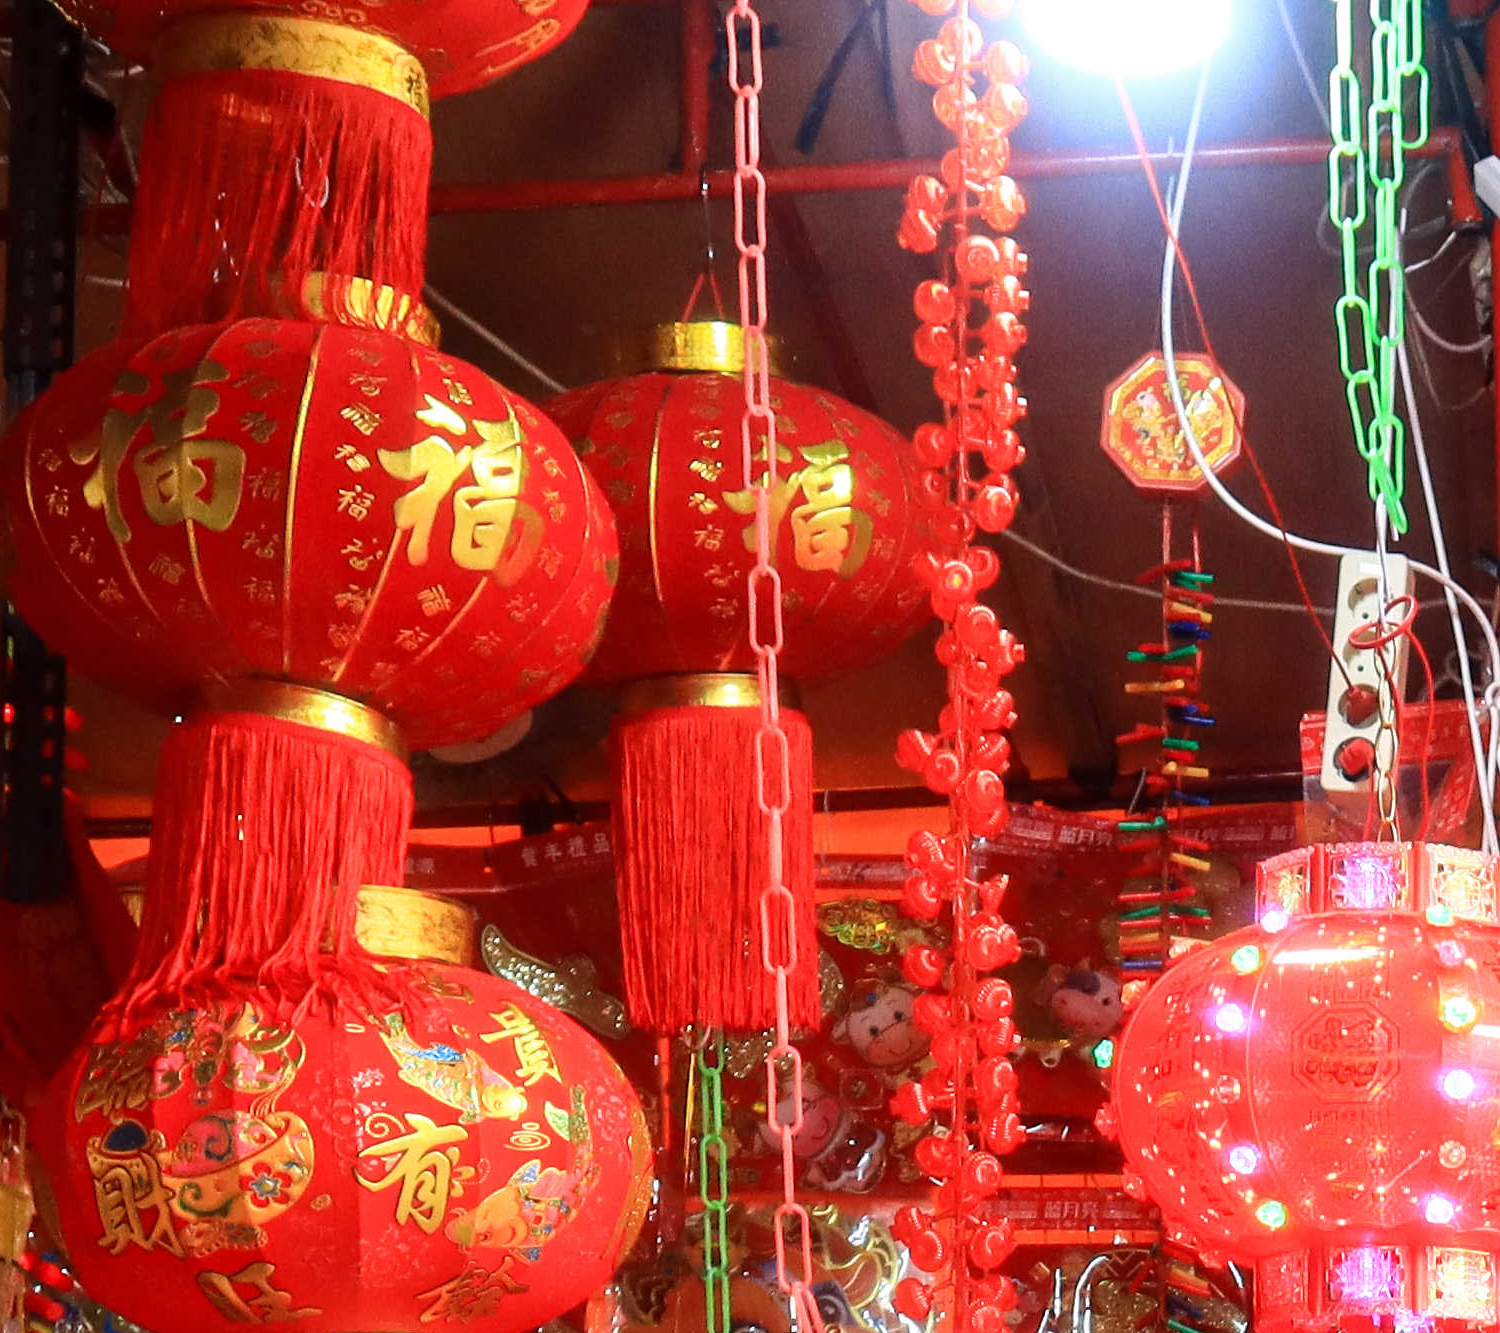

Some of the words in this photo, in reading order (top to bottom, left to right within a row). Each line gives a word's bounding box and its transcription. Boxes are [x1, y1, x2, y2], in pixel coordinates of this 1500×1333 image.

[67, 360, 246, 543] 福
[377, 393, 544, 586] 福
[723, 439, 874, 582] 福
[481, 1004, 563, 1086] 貴
[94, 1154, 186, 1260] 財
[356, 1113, 469, 1235] 有
